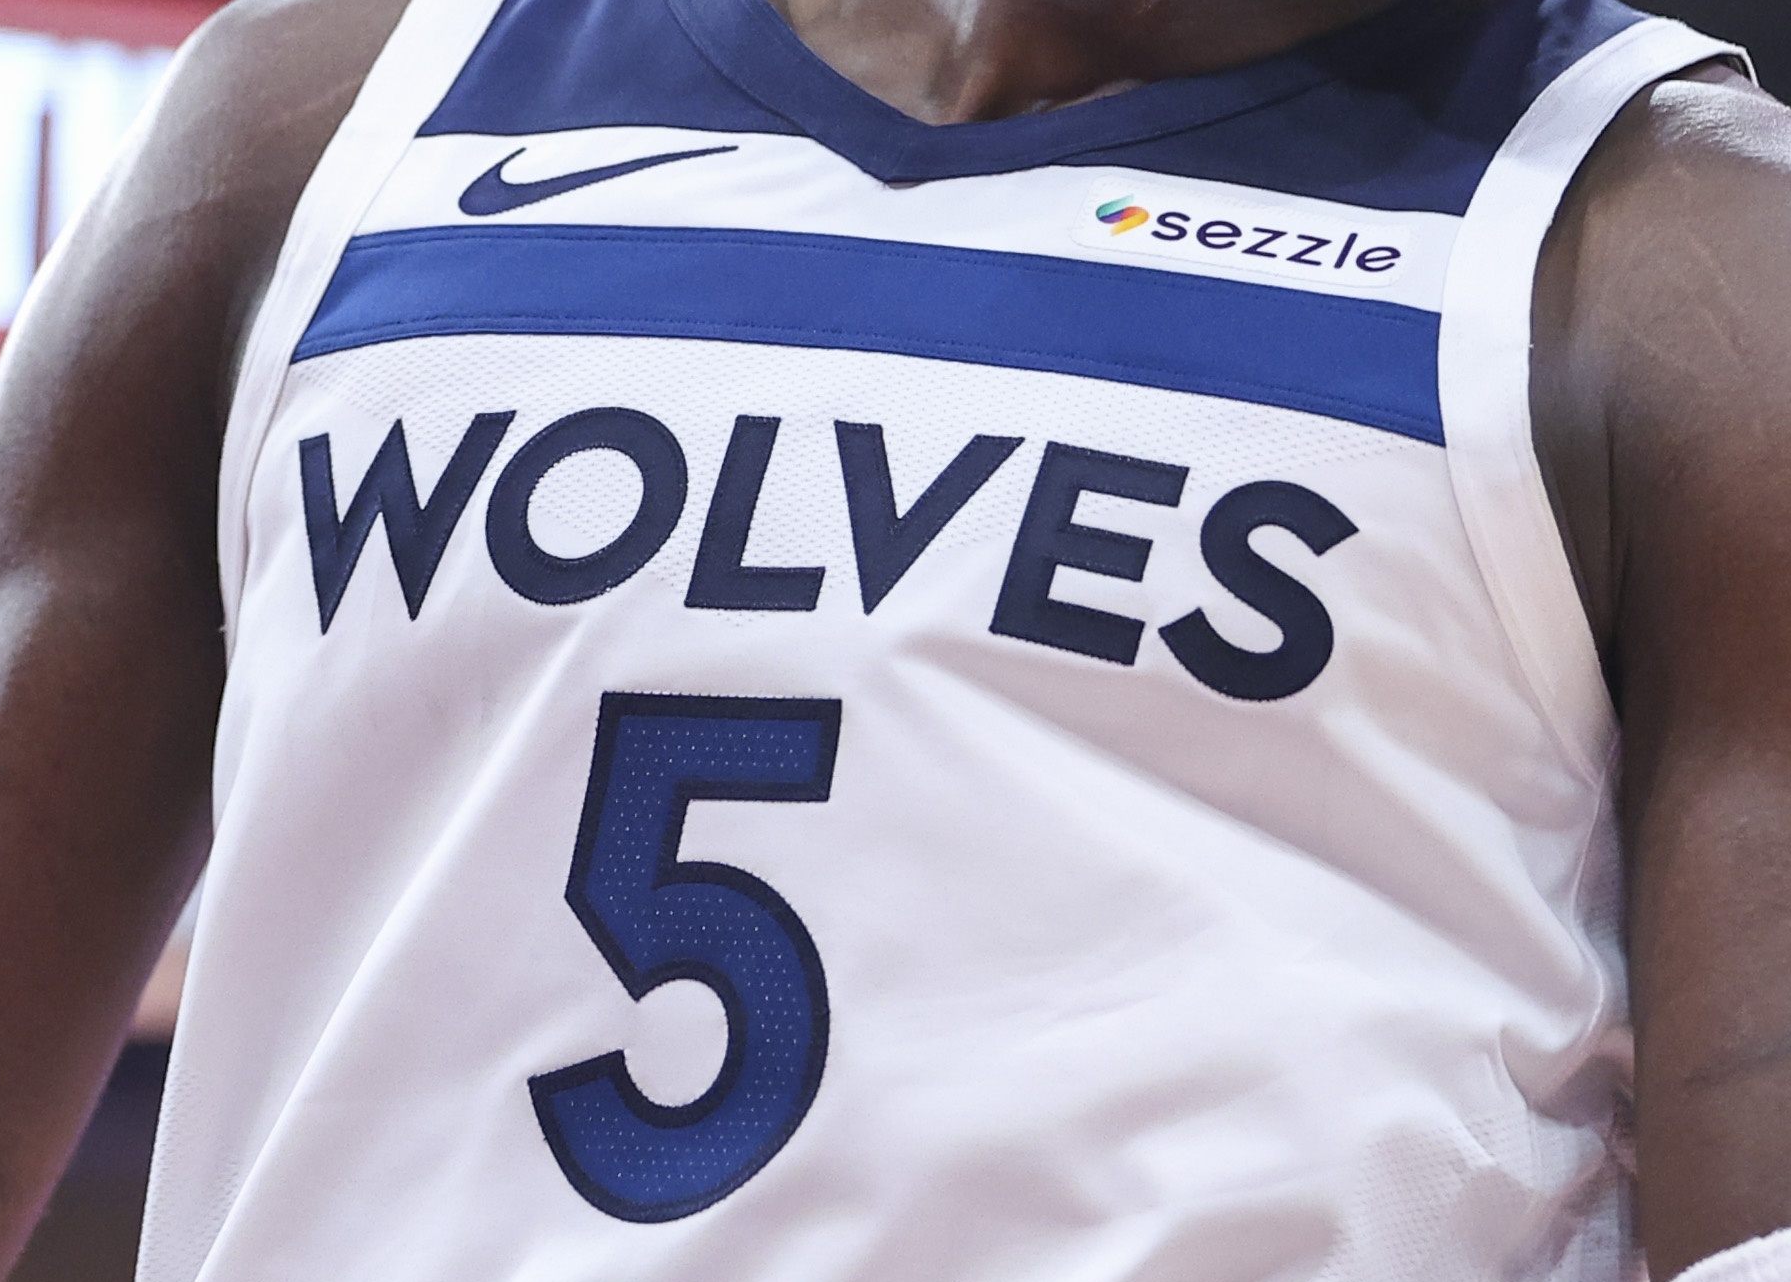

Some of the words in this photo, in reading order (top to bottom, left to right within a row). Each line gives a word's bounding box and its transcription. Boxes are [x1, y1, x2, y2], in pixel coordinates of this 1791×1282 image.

[1151, 211, 1401, 272] sezzle
[298, 407, 1360, 702] WOLVES
[527, 690, 843, 1224] 5
